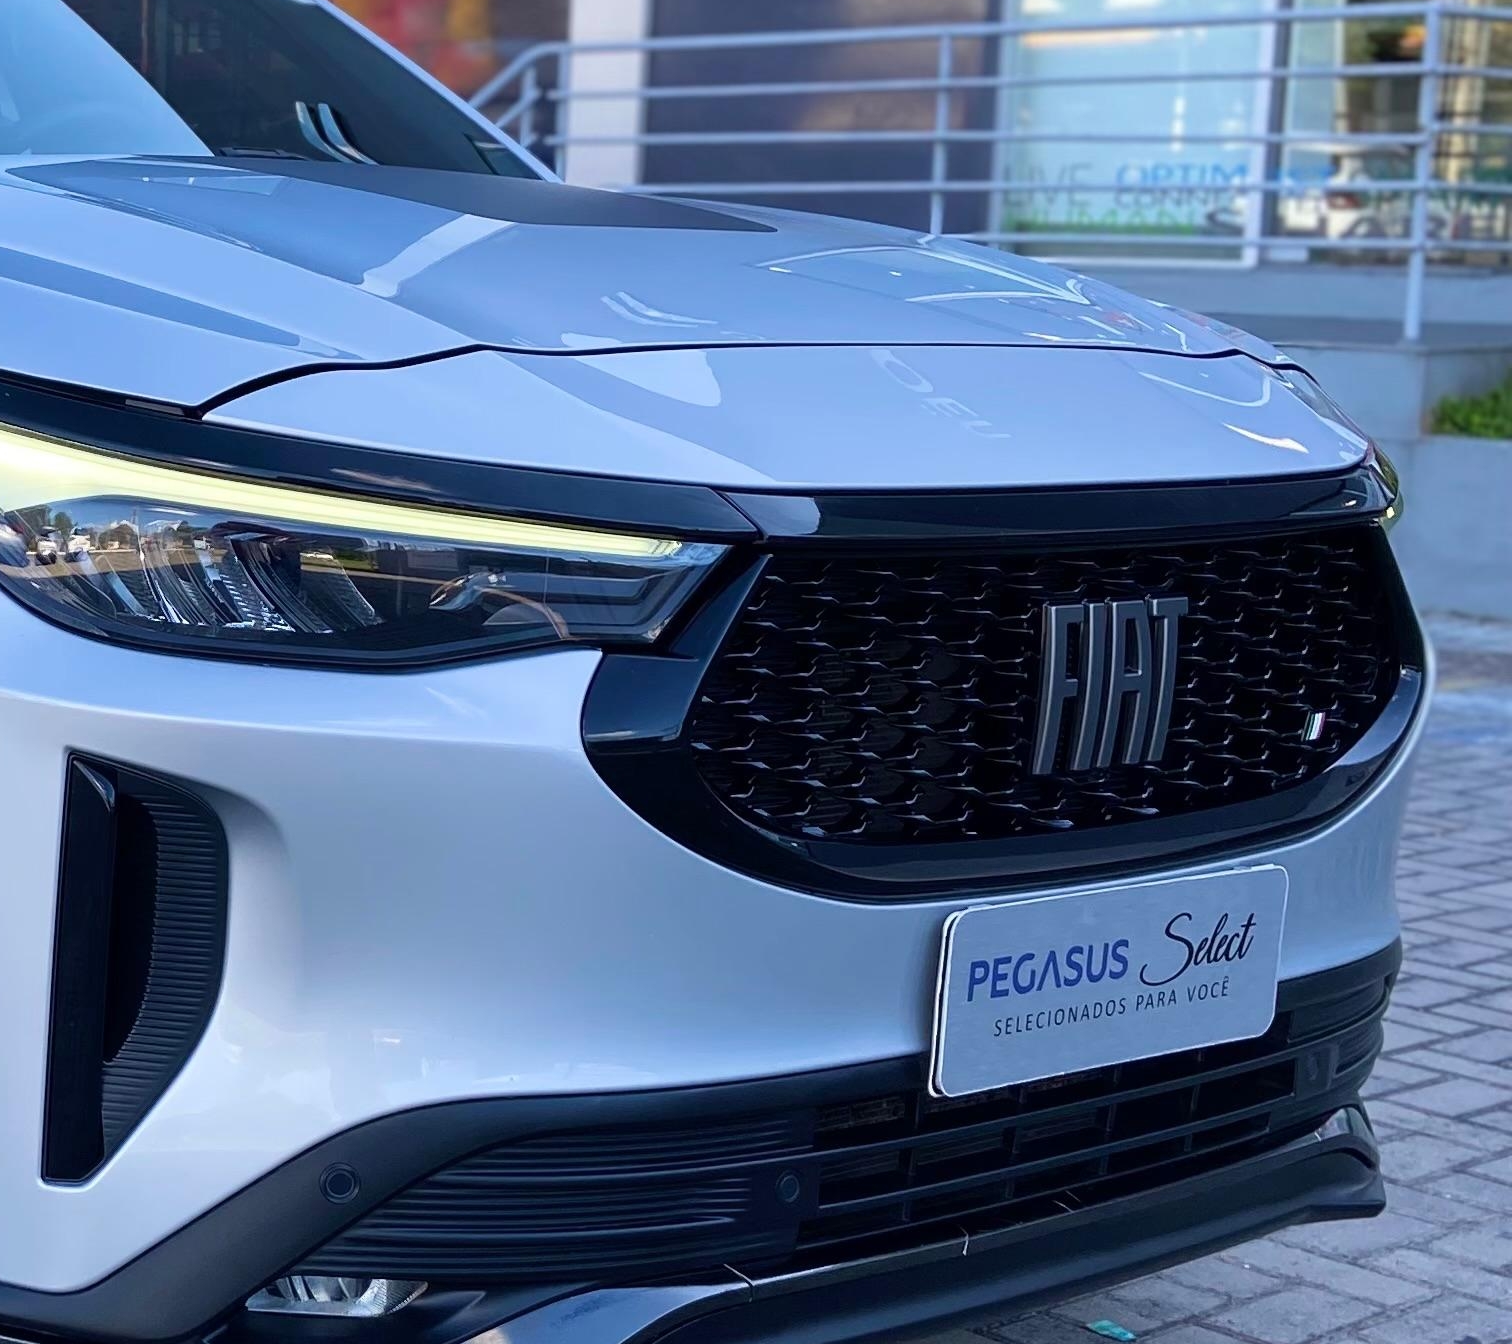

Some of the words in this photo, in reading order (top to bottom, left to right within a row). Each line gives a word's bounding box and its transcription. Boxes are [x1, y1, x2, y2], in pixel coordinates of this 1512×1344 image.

[1031, 596, 1189, 775] FIAT
[966, 938, 1130, 1002] PEGASUS
[1139, 912, 1257, 987] Select
[992, 997, 1127, 1038] SELECIONADOS
[1135, 986, 1178, 1012] PARA
[1187, 975, 1230, 1003] VOCÊ
